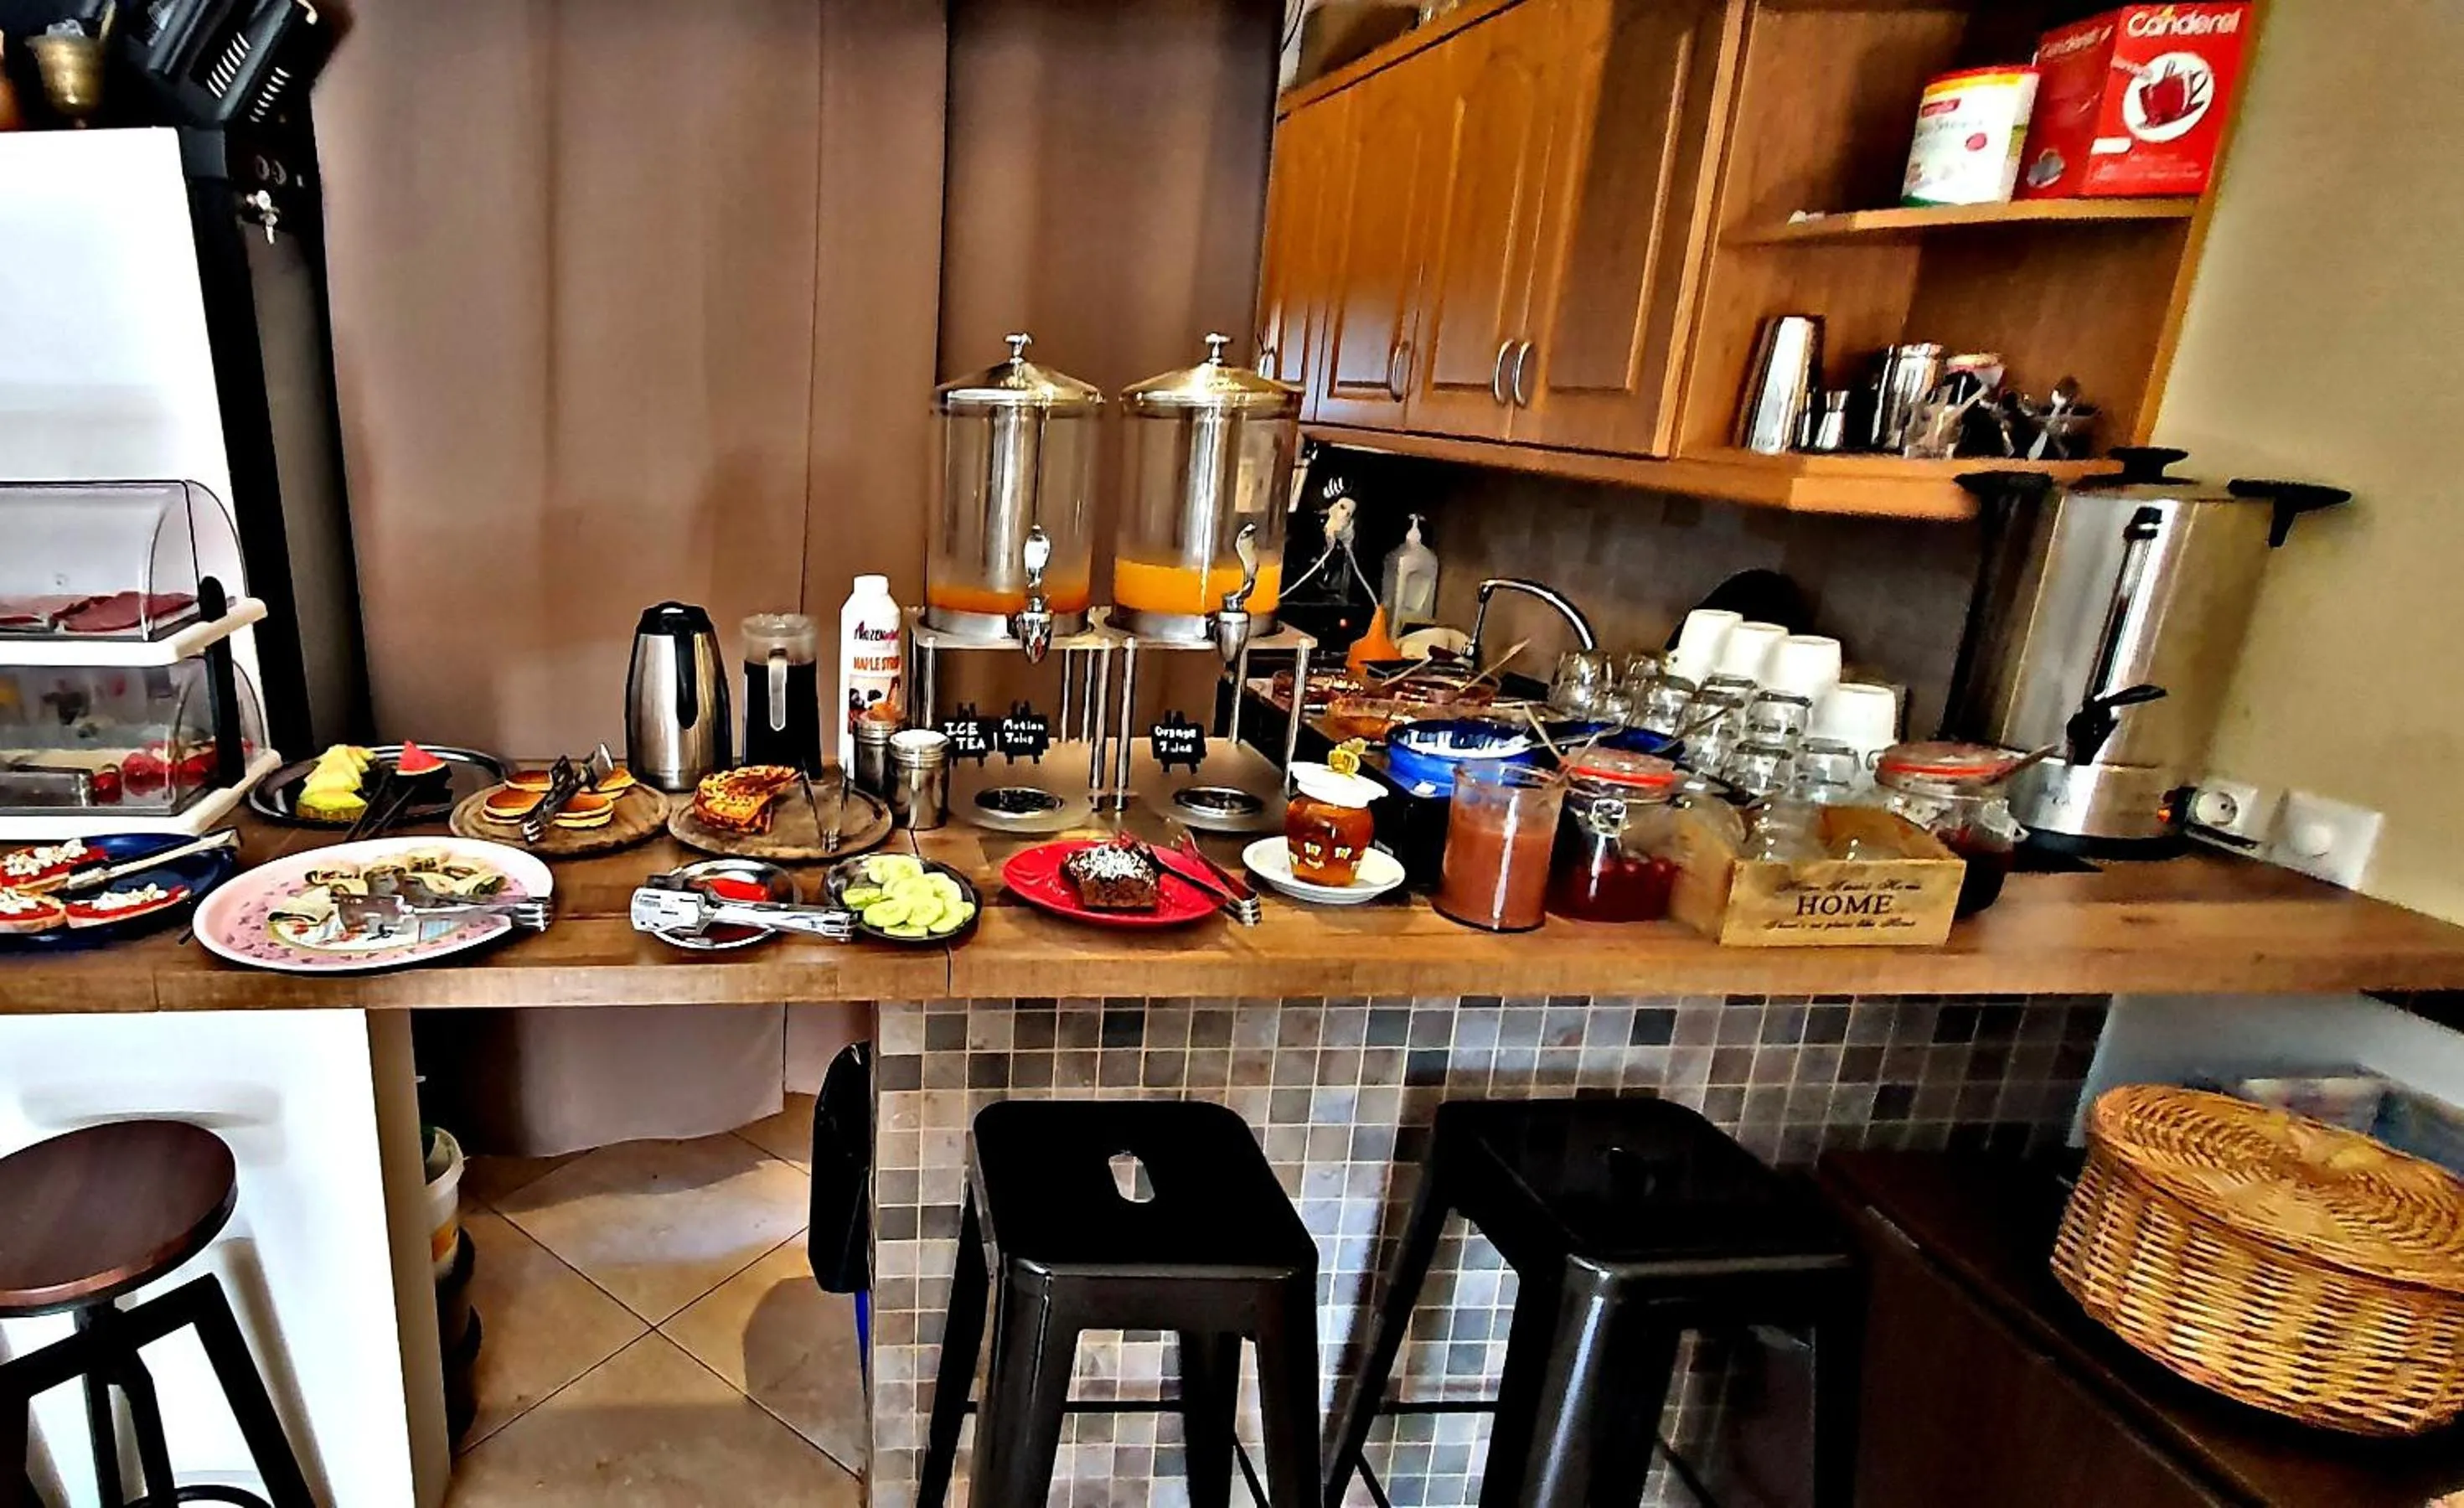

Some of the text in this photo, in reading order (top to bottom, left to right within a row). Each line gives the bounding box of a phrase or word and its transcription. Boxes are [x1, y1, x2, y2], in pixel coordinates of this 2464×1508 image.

[2127, 8, 2244, 38] Canderel
[943, 722, 979, 736] ICE
[956, 737, 986, 750] TEA
[1795, 894, 1895, 916] HOME
